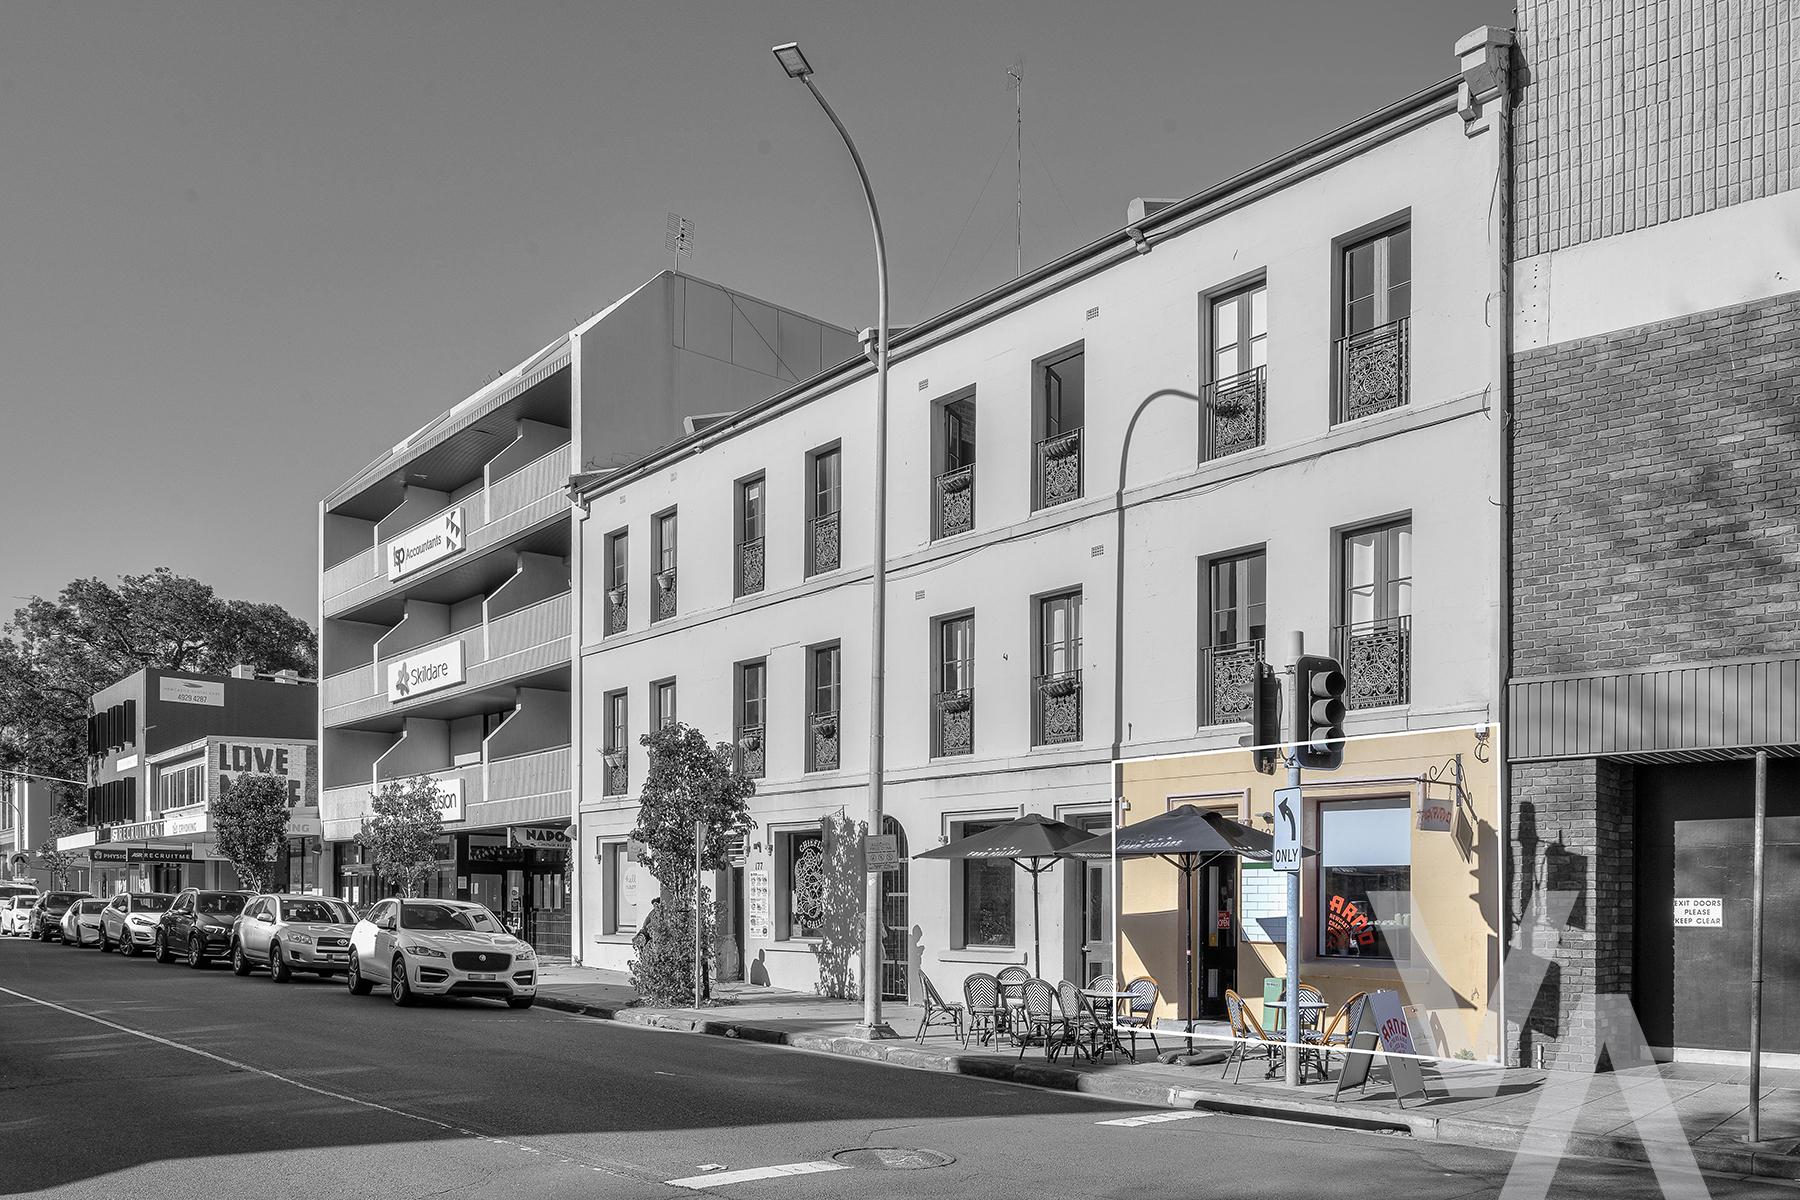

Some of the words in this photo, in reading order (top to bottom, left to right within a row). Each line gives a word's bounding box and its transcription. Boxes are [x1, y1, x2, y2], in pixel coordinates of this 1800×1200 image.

[406, 535, 441, 560] Accountants
[411, 663, 448, 685] Skildare
[220, 743, 288, 775] LOVE
[144, 852, 190, 860] RECRUITME
[1276, 848, 1298, 862] ONLY
[1329, 895, 1375, 945] ARNO
[1381, 1018, 1408, 1042] ARNO
